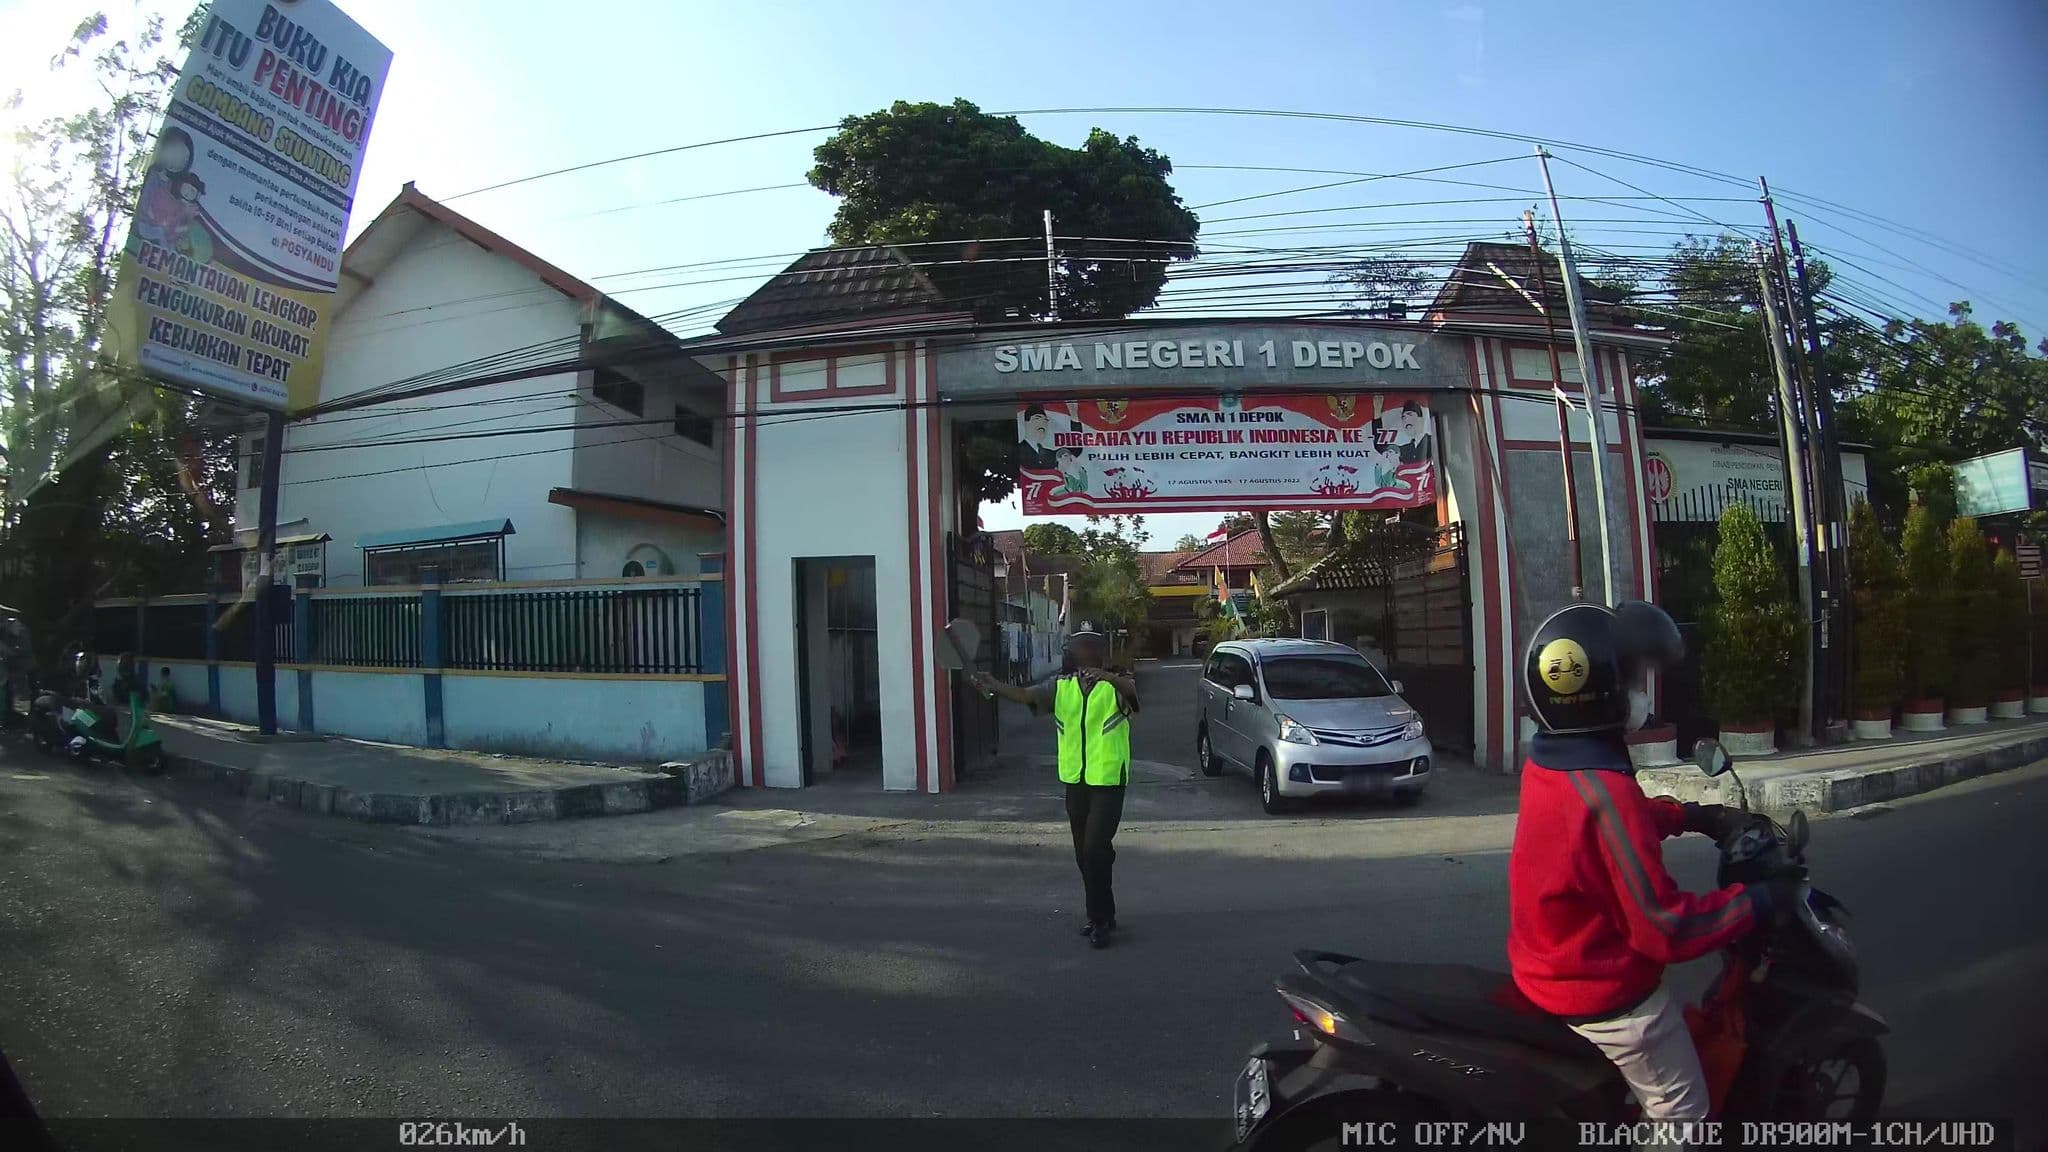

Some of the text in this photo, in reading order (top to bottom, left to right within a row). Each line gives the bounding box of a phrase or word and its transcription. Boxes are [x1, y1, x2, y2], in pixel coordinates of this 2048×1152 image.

[255, 4, 328, 77] BUKU
[201, 15, 369, 148] ITU PENTING!
[250, 90, 276, 112] bagian
[277, 107, 299, 126] untuk
[186, 75, 352, 188] GAMBANG STUNTING
[207, 149, 238, 171] dengan
[238, 166, 279, 192] memantau
[280, 188, 329, 220] pertumbuhan
[229, 194, 253, 214] balita
[293, 227, 316, 245] setiap
[316, 237, 337, 255] bulan
[255, 192, 312, 226] perkembangan
[137, 240, 250, 304] PEMANTAUAN
[280, 238, 335, 272] POSYANDU
[137, 277, 249, 336] PENGUKURAN
[149, 316, 240, 367] KEBIJAKAN
[246, 348, 291, 382] TEPAT
[994, 339, 1421, 373] SMA NEGERI 1 DEPOK
[1176, 410, 1284, 424] SMA N 1 DEPOK
[1054, 430, 1157, 448] DIRGAHAYU
[1162, 429, 1246, 446] REPUBLIK
[1249, 428, 1340, 445] INDONESIA
[1343, 428, 1364, 444] KE
[1375, 428, 1398, 445] 77
[1130, 449, 1176, 462] LEBIH
[1179, 449, 1225, 462] CEPAT,
[1229, 448, 1292, 461] BANGKIT
[1295, 448, 1335, 460] LEBIH
[1336, 448, 1371, 460] KUAT
[1025, 481, 1043, 501] 77
[1178, 478, 1213, 486] AGUSTUS
[1249, 477, 1281, 485] AGUSTUS
[1416, 471, 1431, 492] 77
[1727, 477, 1783, 492] SMA NEGERI
